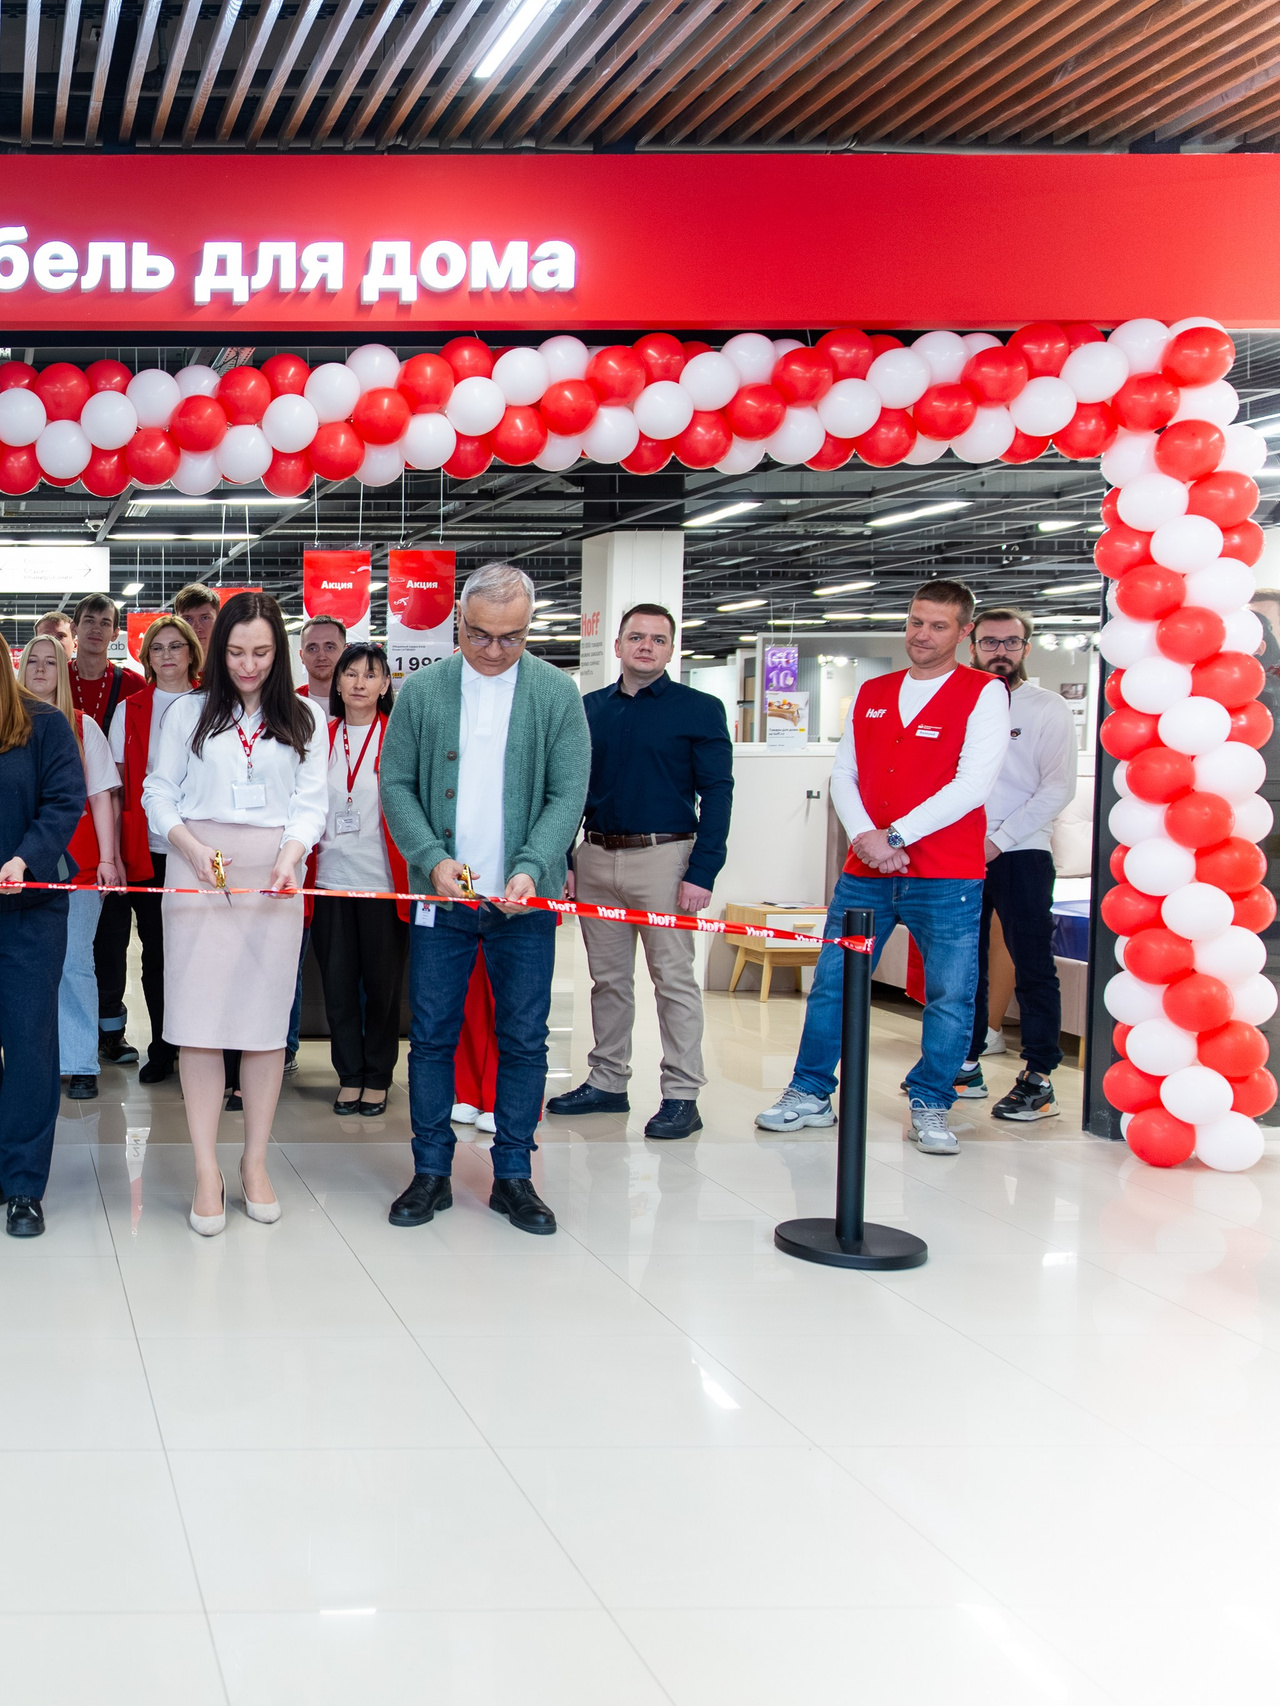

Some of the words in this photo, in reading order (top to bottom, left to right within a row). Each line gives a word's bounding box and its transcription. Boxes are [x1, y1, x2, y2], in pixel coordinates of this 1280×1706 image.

[194, 240, 344, 305] для
[361, 239, 576, 305] дома
[320, 580, 353, 591] Акция
[406, 580, 439, 591] Акция
[580, 611, 601, 638] Hoff
[865, 708, 887, 719] Hoff
[547, 900, 577, 913] Hoff
[596, 906, 627, 920] Hoff
[647, 912, 677, 928] Hoff
[696, 918, 726, 933] Hoff
